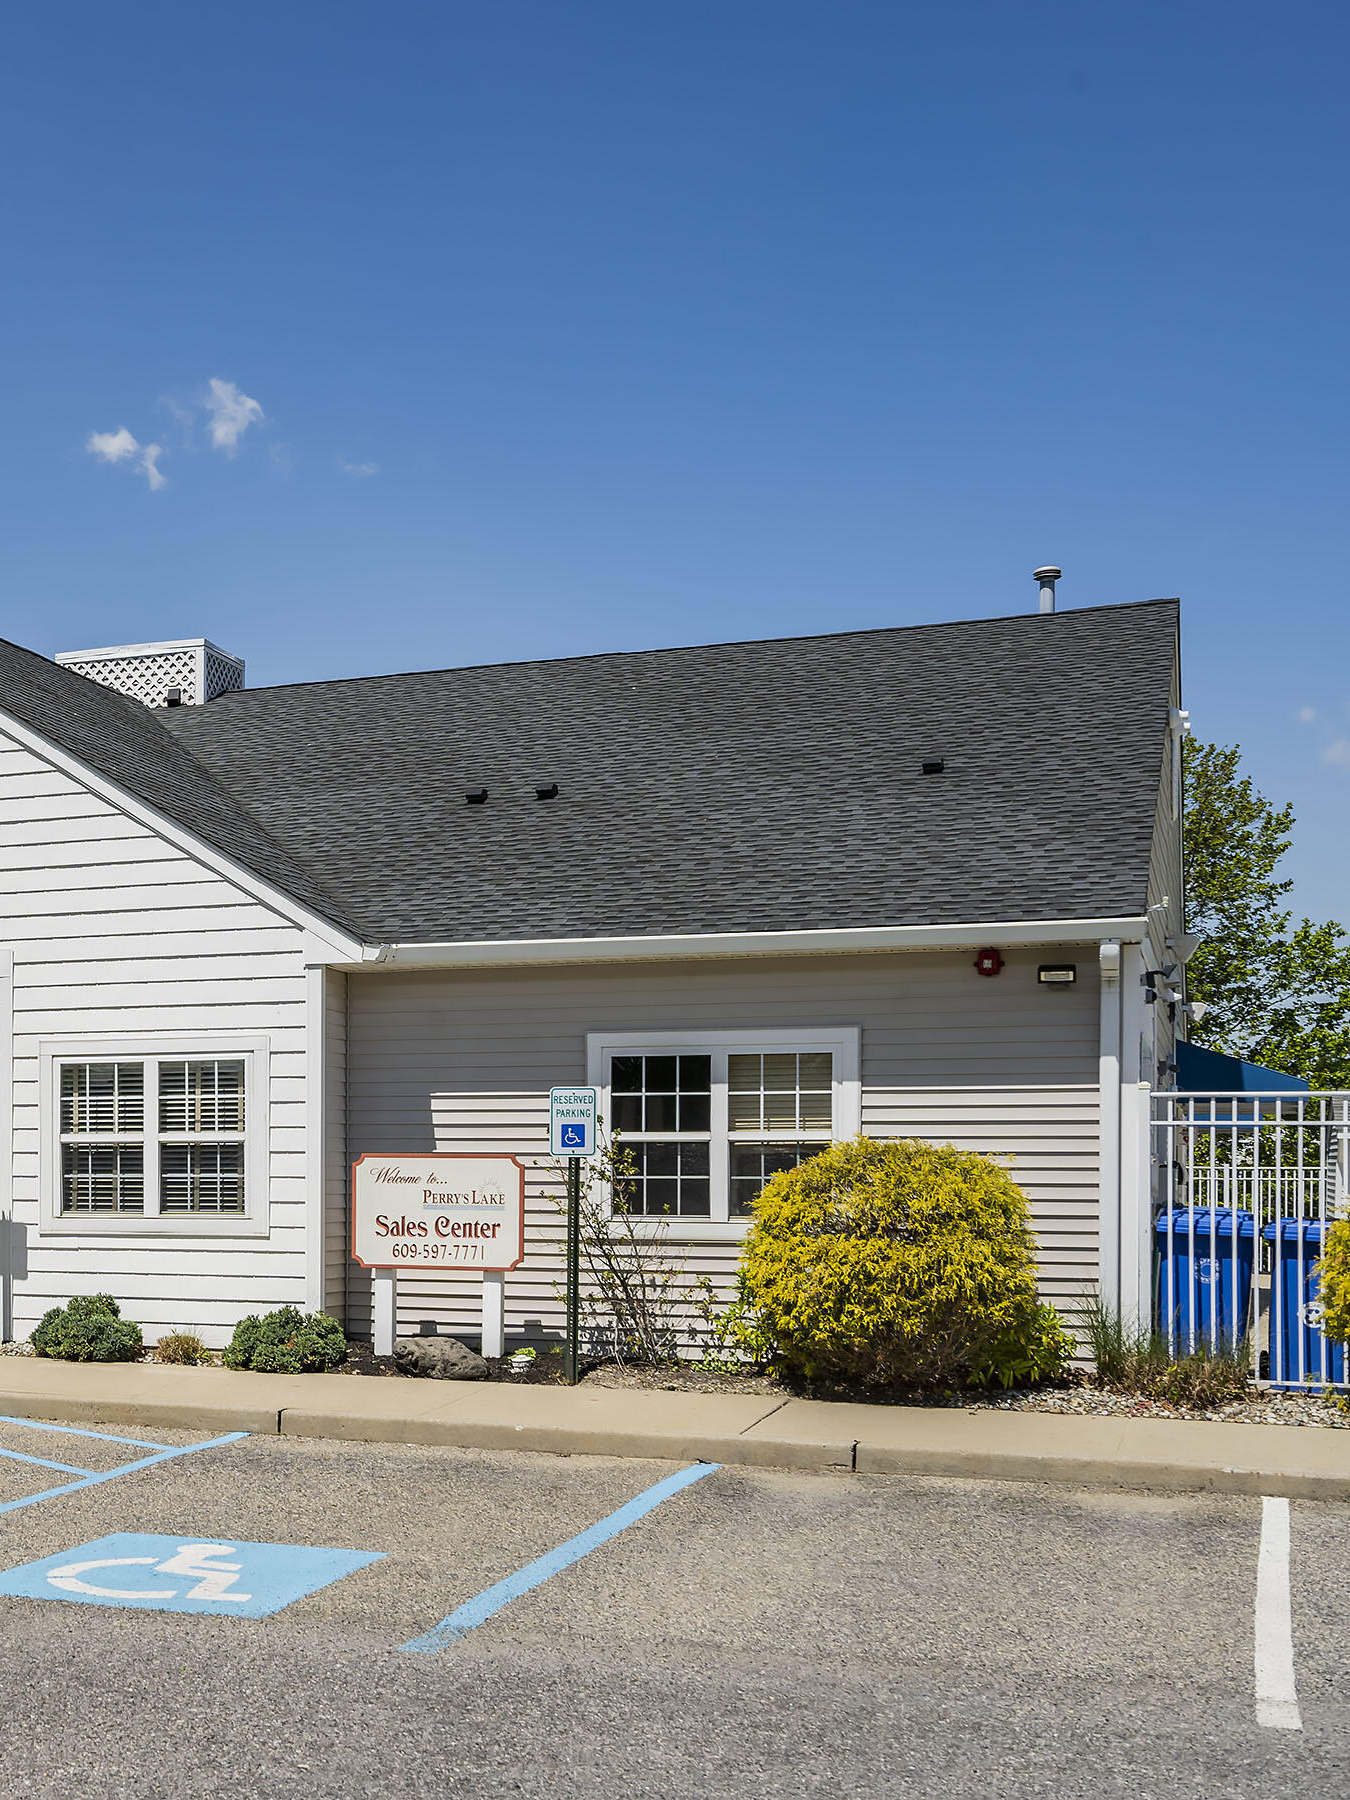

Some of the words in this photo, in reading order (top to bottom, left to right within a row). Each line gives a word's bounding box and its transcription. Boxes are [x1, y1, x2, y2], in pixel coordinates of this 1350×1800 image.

[554, 1095, 593, 1104] RESERVED
[556, 1108, 591, 1117] PARKING
[370, 1166, 421, 1184] Welcome
[375, 1214, 428, 1237] Sales
[434, 1216, 501, 1239] Center
[392, 1243, 484, 1260] 609-597-7771
